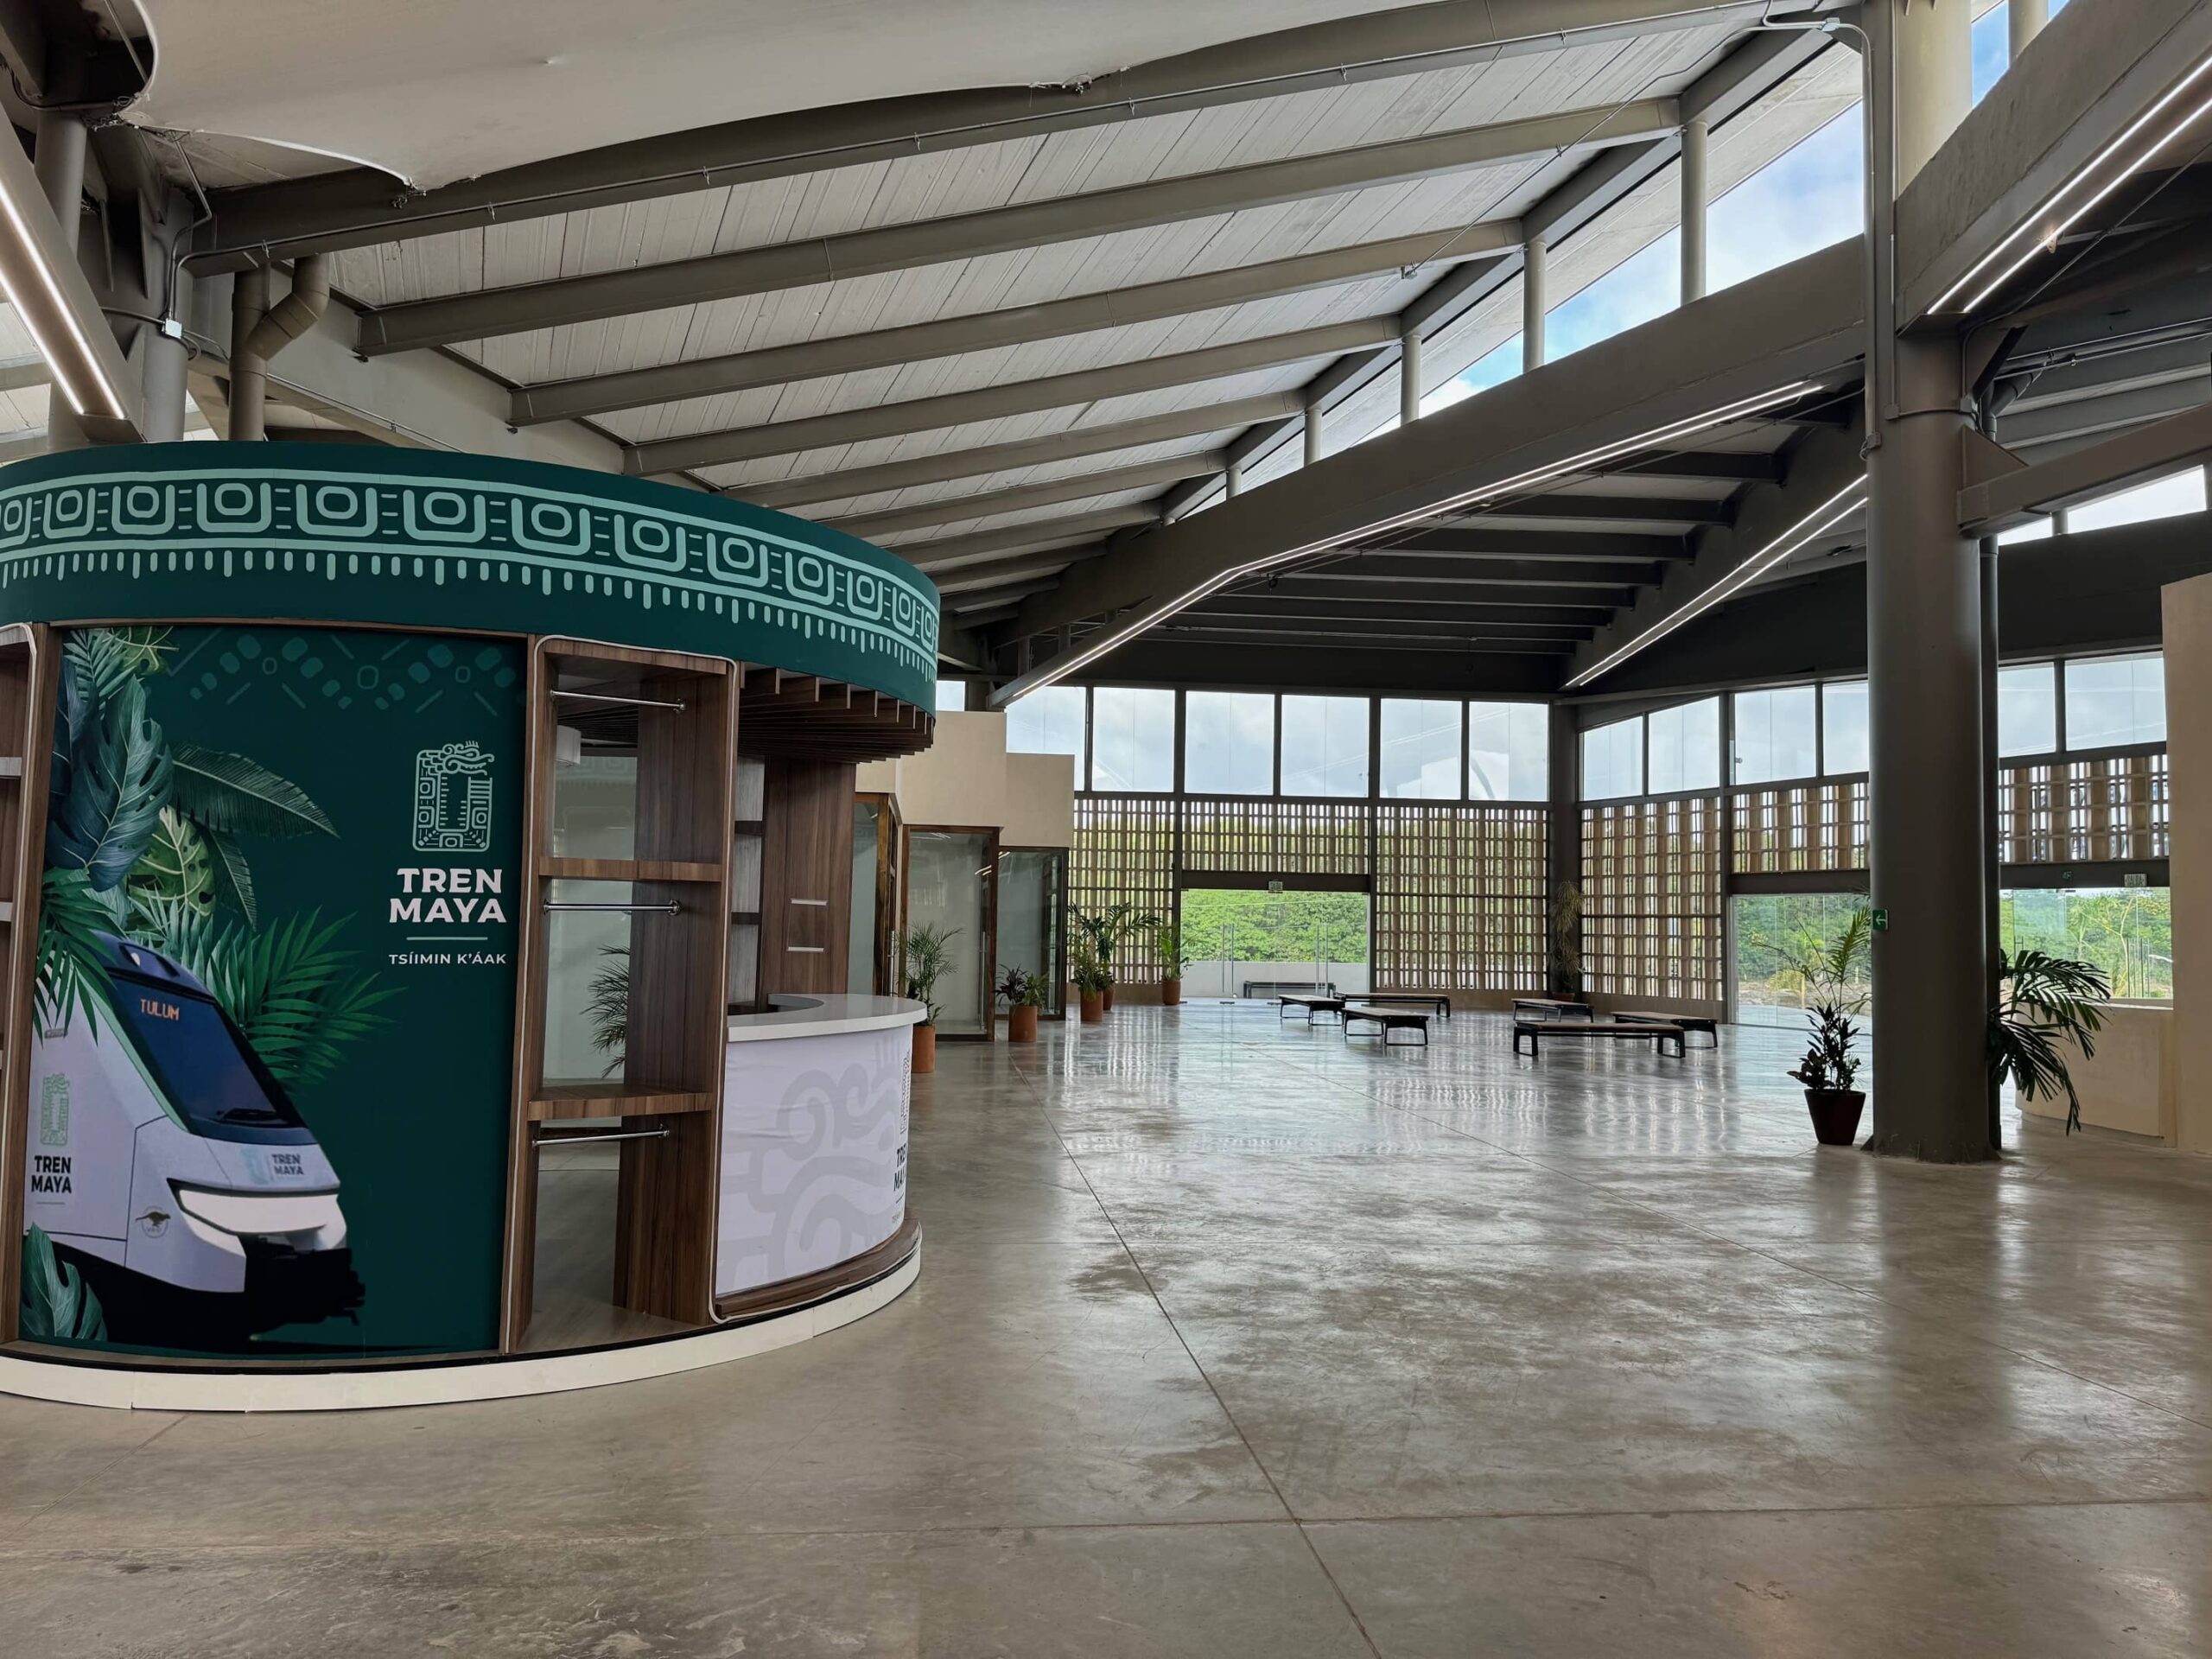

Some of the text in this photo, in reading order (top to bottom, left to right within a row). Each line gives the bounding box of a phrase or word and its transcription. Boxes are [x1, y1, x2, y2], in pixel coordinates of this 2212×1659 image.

[397, 868, 503, 894] TREN
[389, 898, 507, 924] MAYA
[389, 951, 451, 965] TSÍIMIN
[140, 998, 180, 1021] TULUM
[34, 1154, 72, 1174] TREN
[271, 1154, 302, 1165] TREN
[274, 1165, 305, 1175] MAYA
[31, 1175, 72, 1194] MAYA
